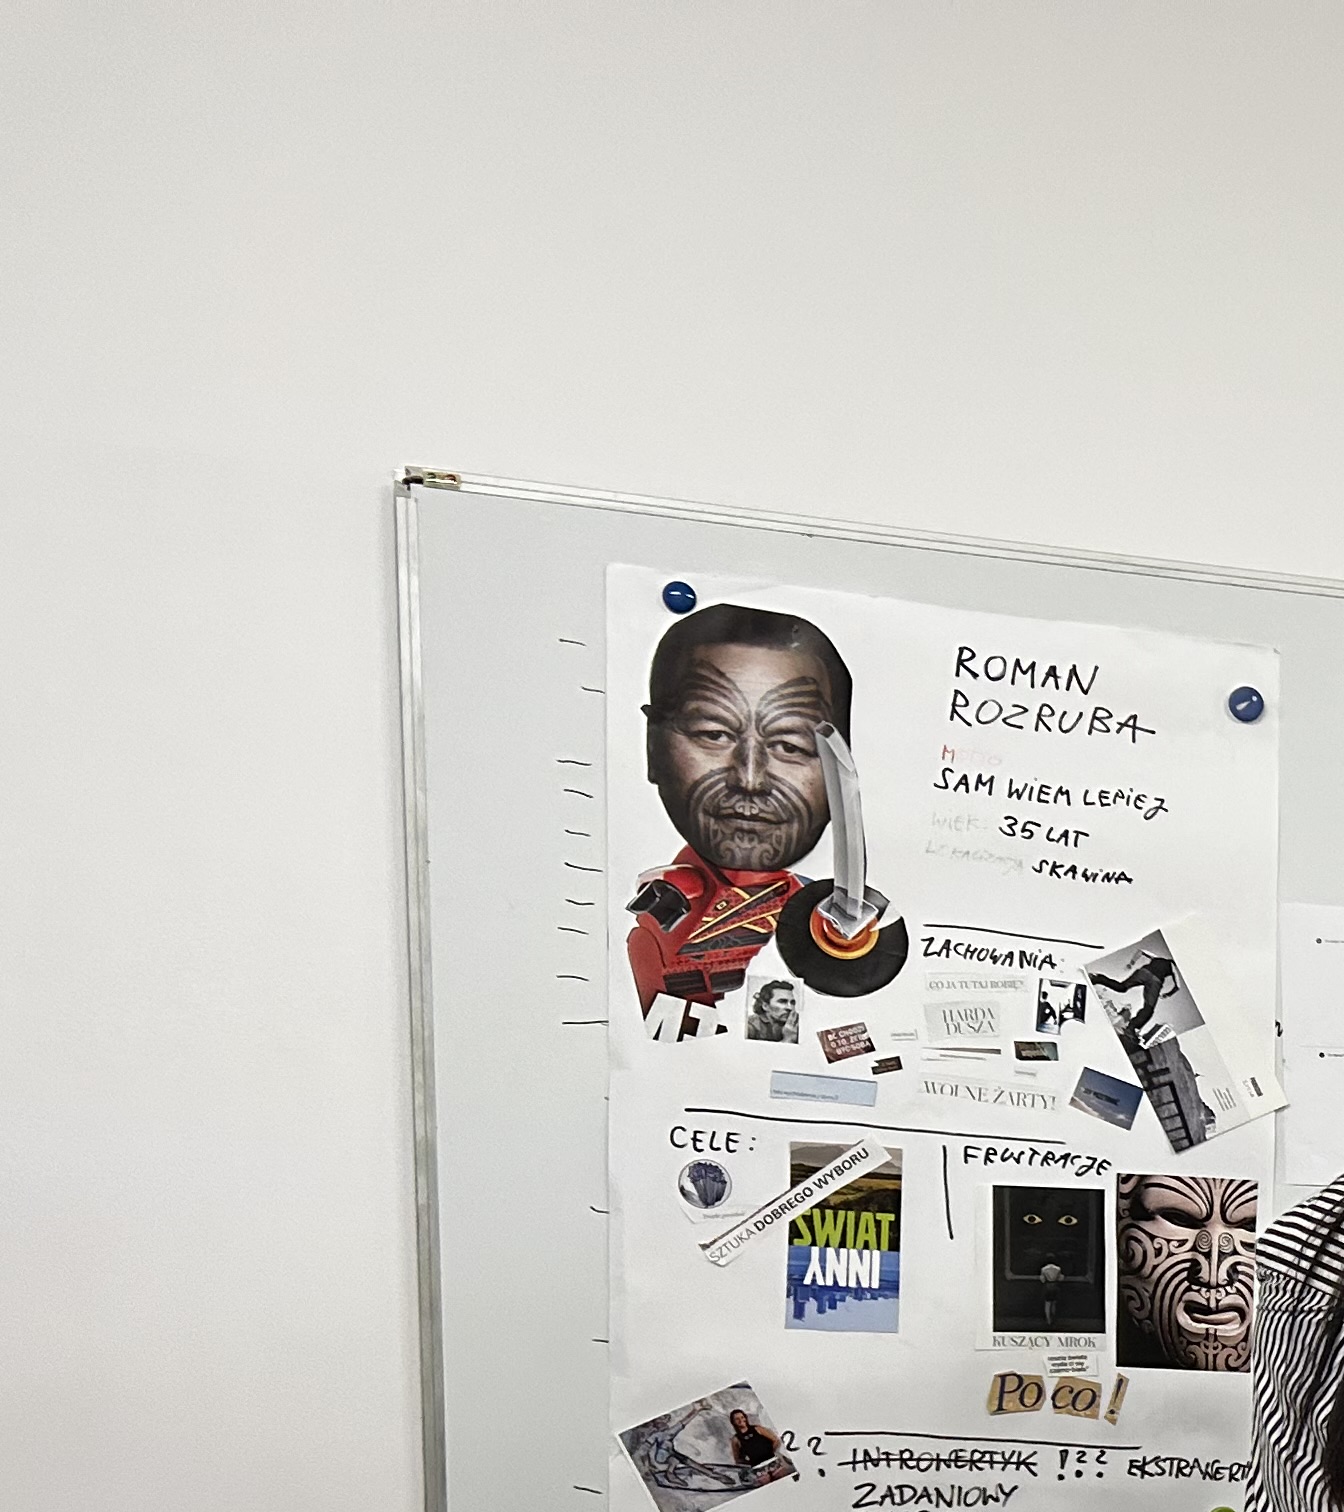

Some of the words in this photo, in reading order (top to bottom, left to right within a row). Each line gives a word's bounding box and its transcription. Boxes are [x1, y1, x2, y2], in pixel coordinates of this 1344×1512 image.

[955, 646, 1100, 696] ROMAN
[949, 689, 1156, 743] ROZRUBA
[934, 767, 996, 797] SAM
[998, 815, 1042, 841] 35
[1046, 827, 1090, 849] LAT
[1031, 859, 1134, 886] SKAWINA
[963, 1145, 1113, 1177] FRUSTRACJE
[709, 1227, 756, 1264] SZTUKA
[753, 1187, 814, 1232] DOBREGO
[812, 1147, 870, 1190] WYBORU
[803, 1246, 881, 1289] INNY
[992, 1334, 1051, 1350] KUSZĄCY
[1056, 1335, 1097, 1348] MROK
[852, 1482, 1019, 1508] ZADANIOWY
